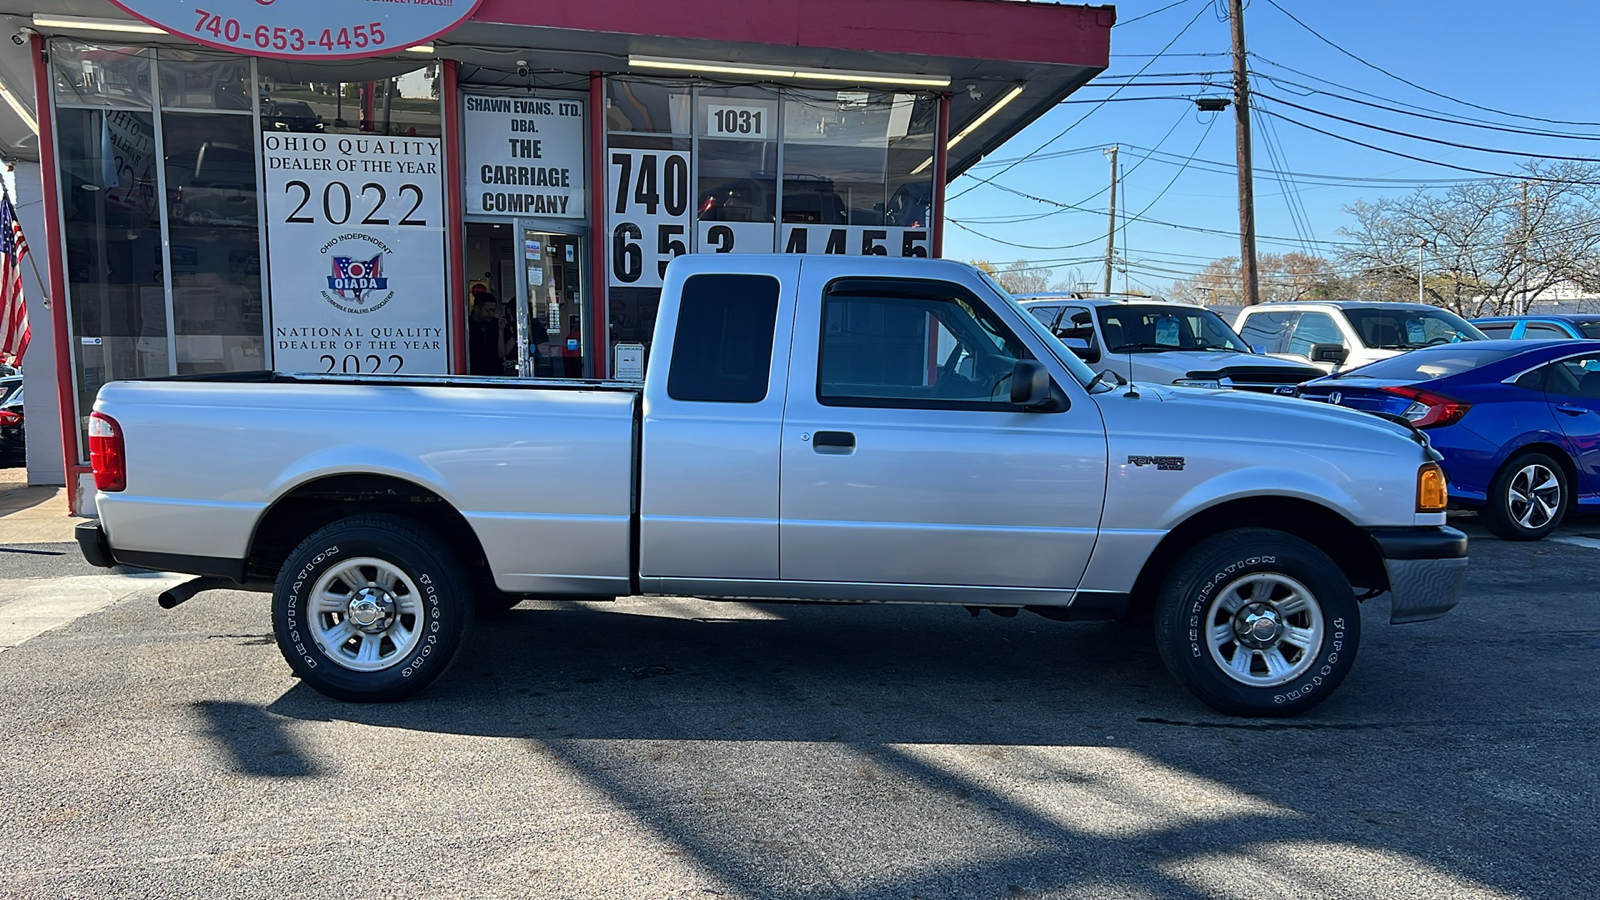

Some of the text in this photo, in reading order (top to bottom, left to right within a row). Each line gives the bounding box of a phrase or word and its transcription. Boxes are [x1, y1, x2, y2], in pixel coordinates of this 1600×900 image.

[194, 9, 385, 51] 740-653-4455
[466, 97, 582, 117] SHAWN EVANS. LTD.
[511, 119, 539, 133] DBA.
[714, 109, 762, 134] 1031
[266, 136, 439, 156] OHIO QUALITY
[508, 138, 542, 159] THE
[269, 156, 438, 175] DEALER OF THE YEAR
[480, 164, 570, 188] CARRIAGE
[612, 152, 688, 217] 740
[285, 180, 427, 227] 2022
[482, 192, 569, 215] COMPANY
[320, 232, 394, 255] OHIO INDEPENDENT
[334, 278, 378, 289] OIADA
[320, 290, 395, 315] AUTOMOBILE DEALERS ASSOCIATION
[276, 327, 443, 339] NATIONAL QUALITY
[278, 340, 441, 350] DEALER OF THE YEAR
[319, 354, 405, 374] 2022
[1128, 455, 1186, 467] RANGER
[287, 545, 340, 669] DESTINATION
[1189, 555, 1276, 658] DESTINATION
